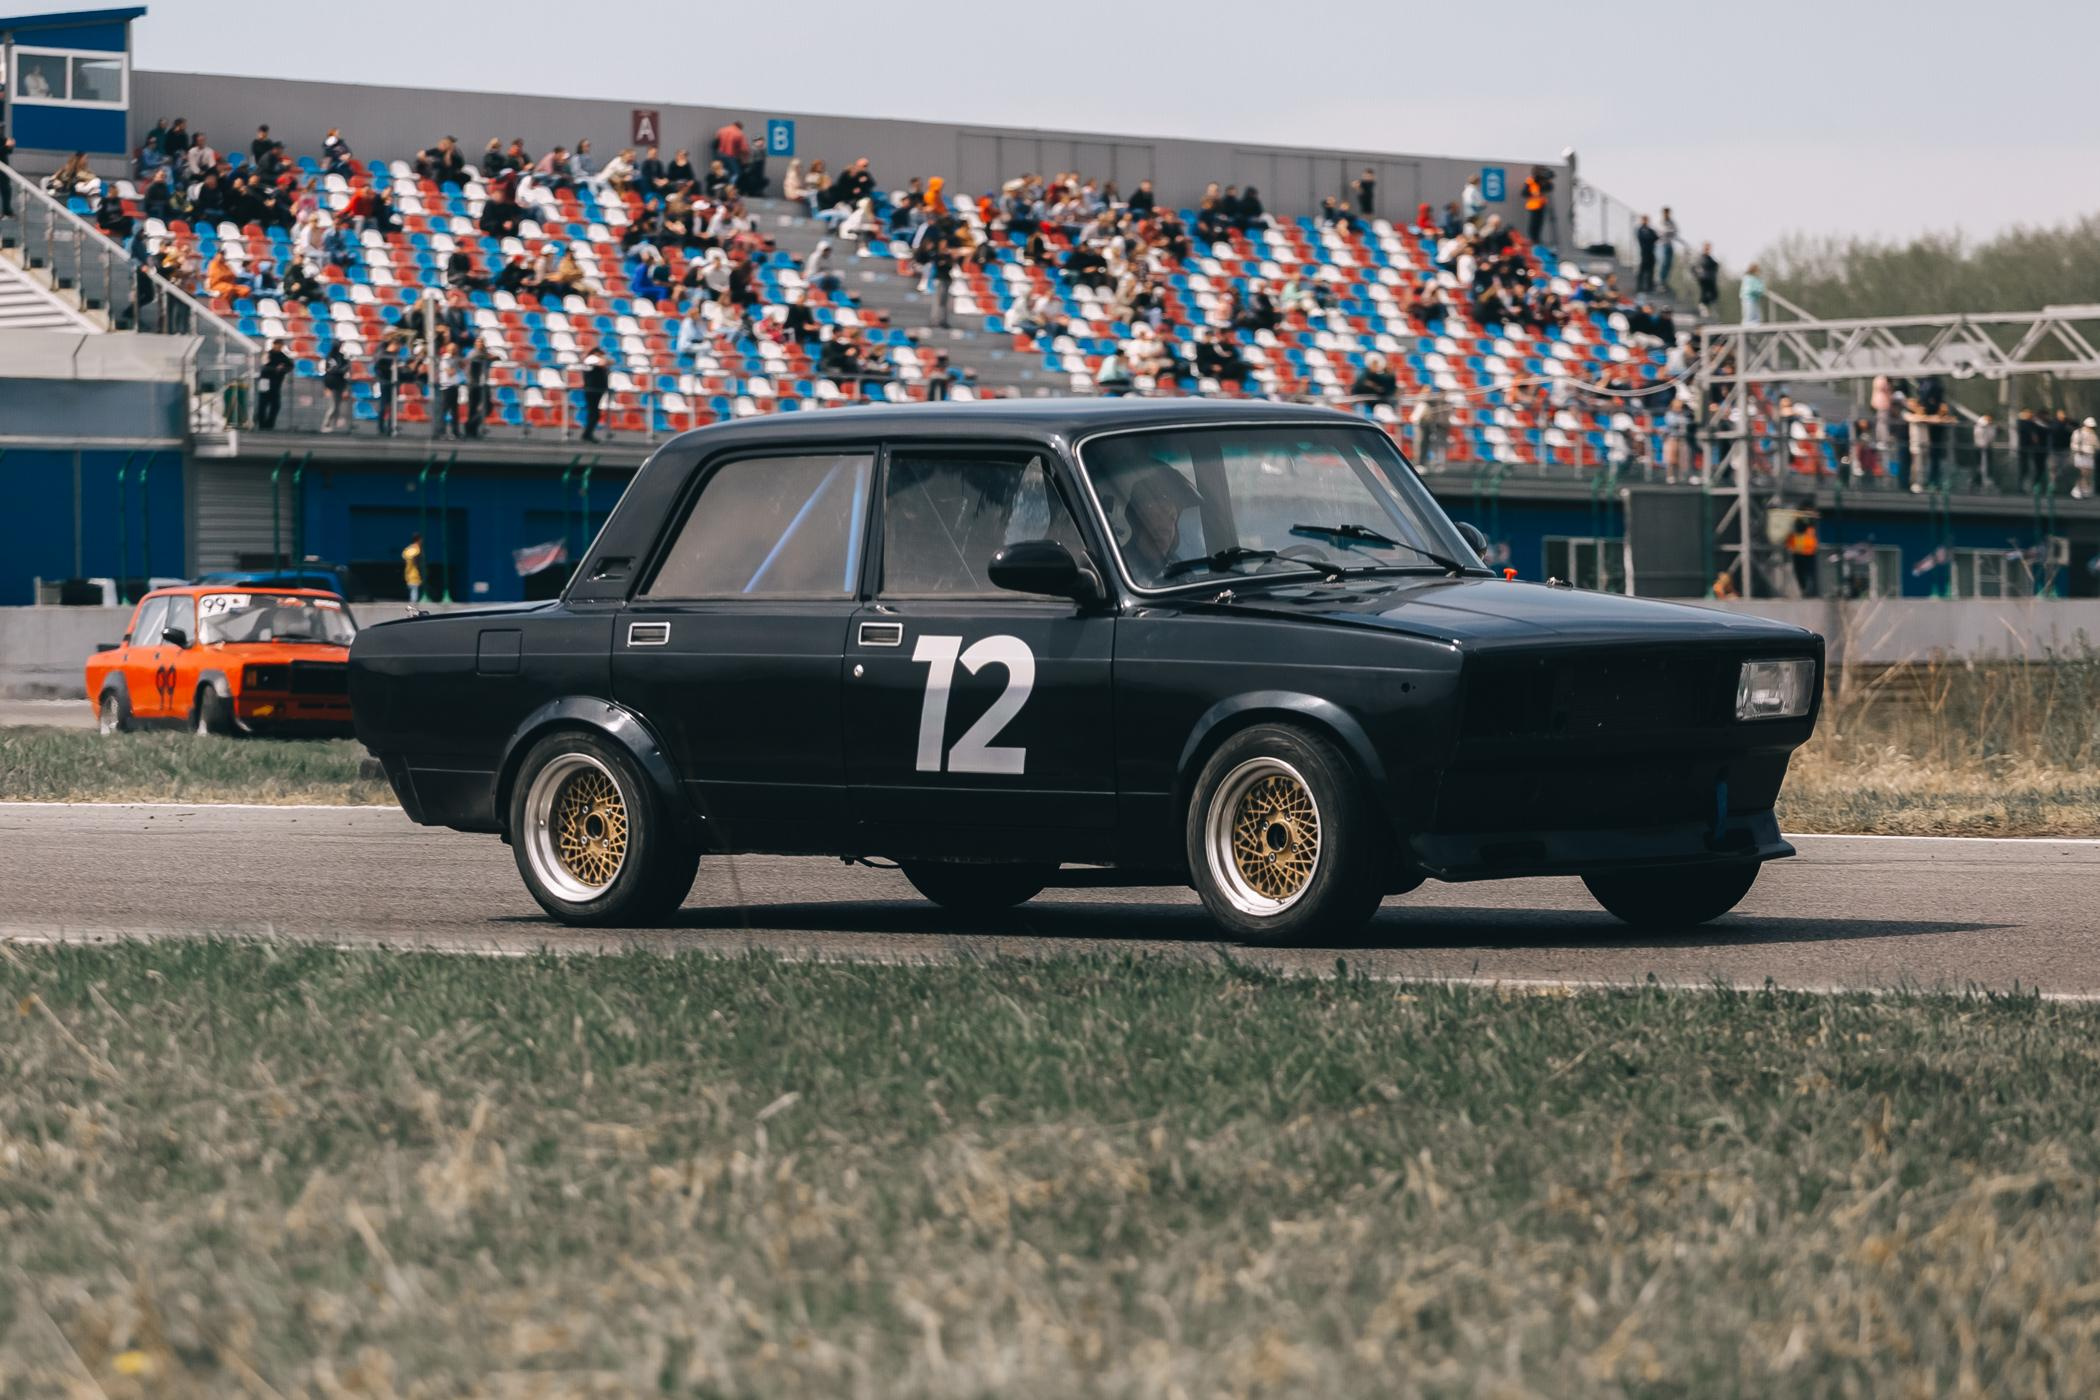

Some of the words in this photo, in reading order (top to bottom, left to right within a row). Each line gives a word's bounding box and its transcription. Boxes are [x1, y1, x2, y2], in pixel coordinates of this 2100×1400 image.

[636, 116, 656, 141] A
[773, 126, 789, 151] B
[203, 597, 226, 613] 99
[155, 664, 177, 711] 99
[912, 635, 1035, 775] 12
